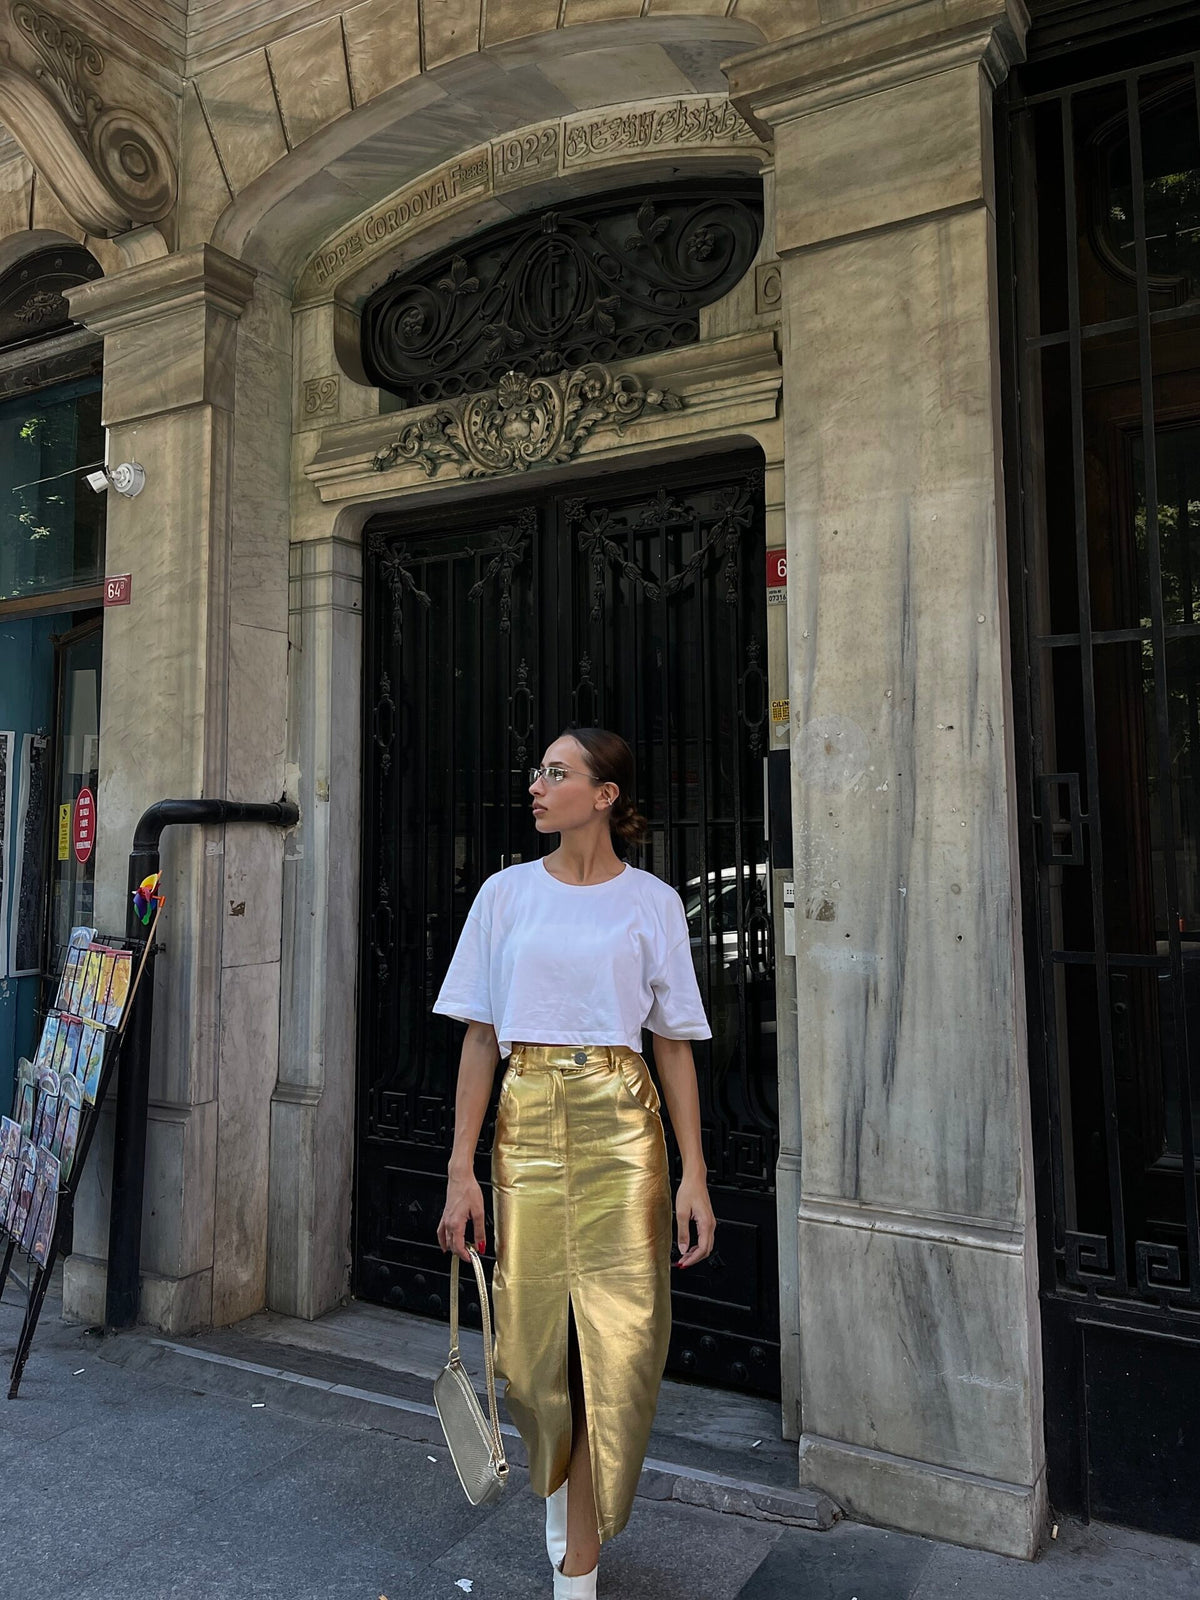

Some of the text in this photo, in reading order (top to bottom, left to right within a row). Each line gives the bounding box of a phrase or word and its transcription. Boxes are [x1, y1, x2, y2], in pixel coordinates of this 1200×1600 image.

[495, 128, 557, 177] 1922
[363, 181, 449, 246] CORDOVA
[305, 379, 337, 414] 52
